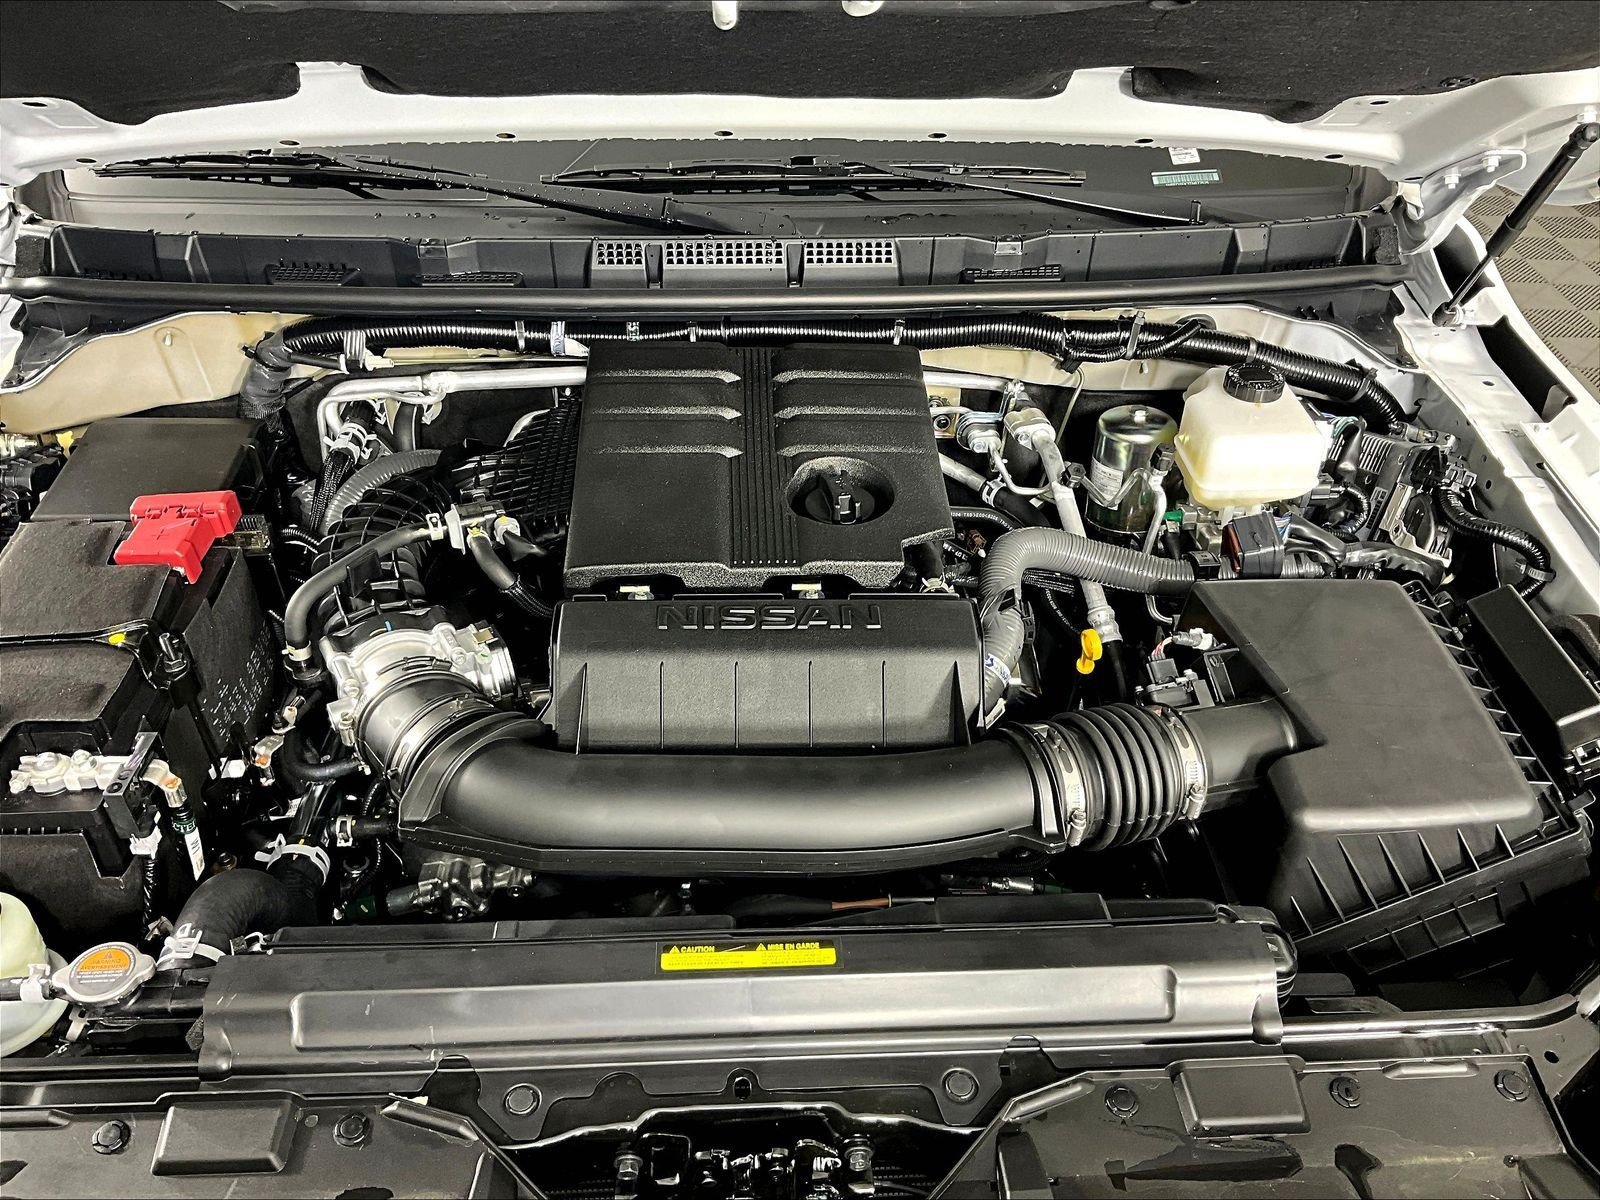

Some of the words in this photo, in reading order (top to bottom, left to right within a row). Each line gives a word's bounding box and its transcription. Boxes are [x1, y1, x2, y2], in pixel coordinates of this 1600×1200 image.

[656, 604, 882, 630] NISSAN
[680, 945, 715, 953] CAUTION
[767, 943, 784, 951] MISE
[795, 942, 820, 950] GARDE
